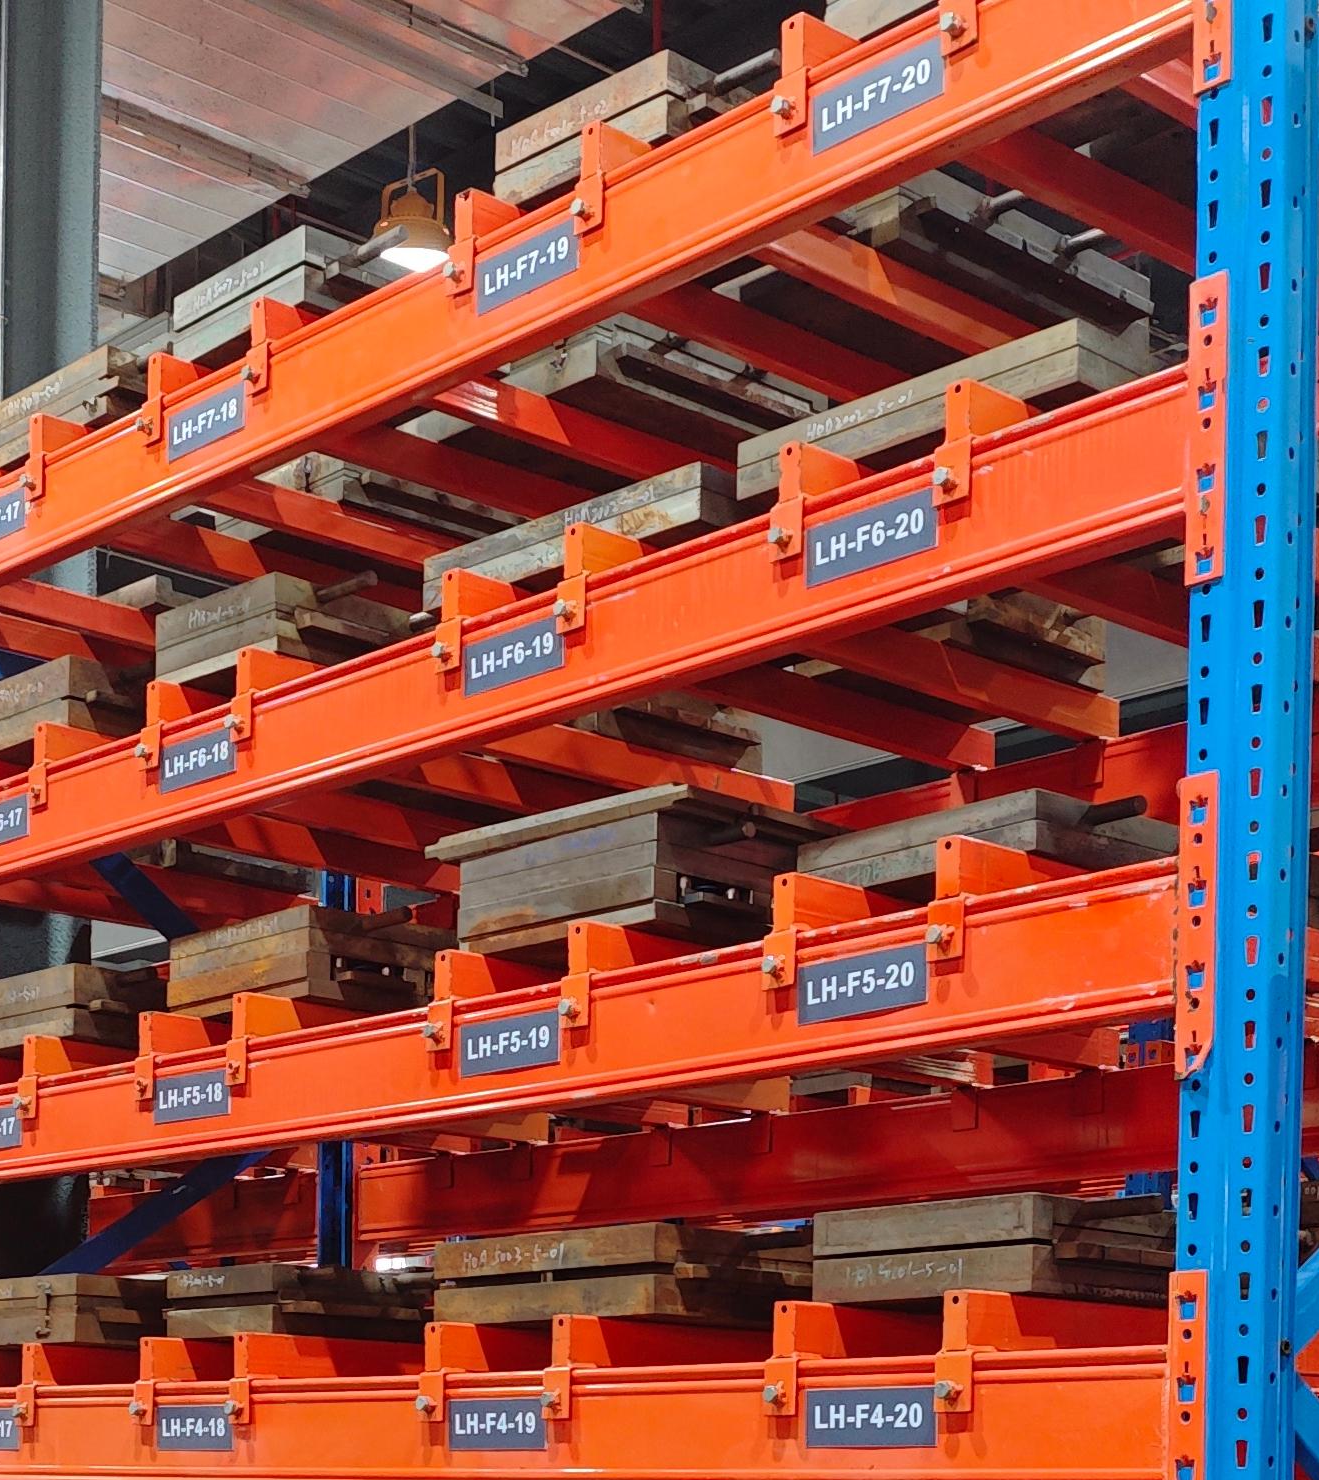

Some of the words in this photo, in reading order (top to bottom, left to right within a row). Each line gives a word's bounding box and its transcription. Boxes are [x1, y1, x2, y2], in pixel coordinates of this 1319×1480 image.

[821, 58, 931, 132] LH-F7-20
[483, 236, 569, 296] LH-F7-19
[173, 398, 237, 446] LH-F7-18
[815, 508, 925, 568] LH-F6-20
[471, 631, 554, 680] LH-F6-19
[165, 740, 229, 778] LH-F6-18
[806, 962, 915, 1005] LH-F5-20
[467, 1024, 550, 1061] LH-F5-19
[159, 1083, 223, 1109] LH-F5-18
[162, 1417, 226, 1438] LH-F4-18
[455, 1412, 537, 1435] LH-F4-19
[814, 1402, 923, 1429] LH-F4-20
